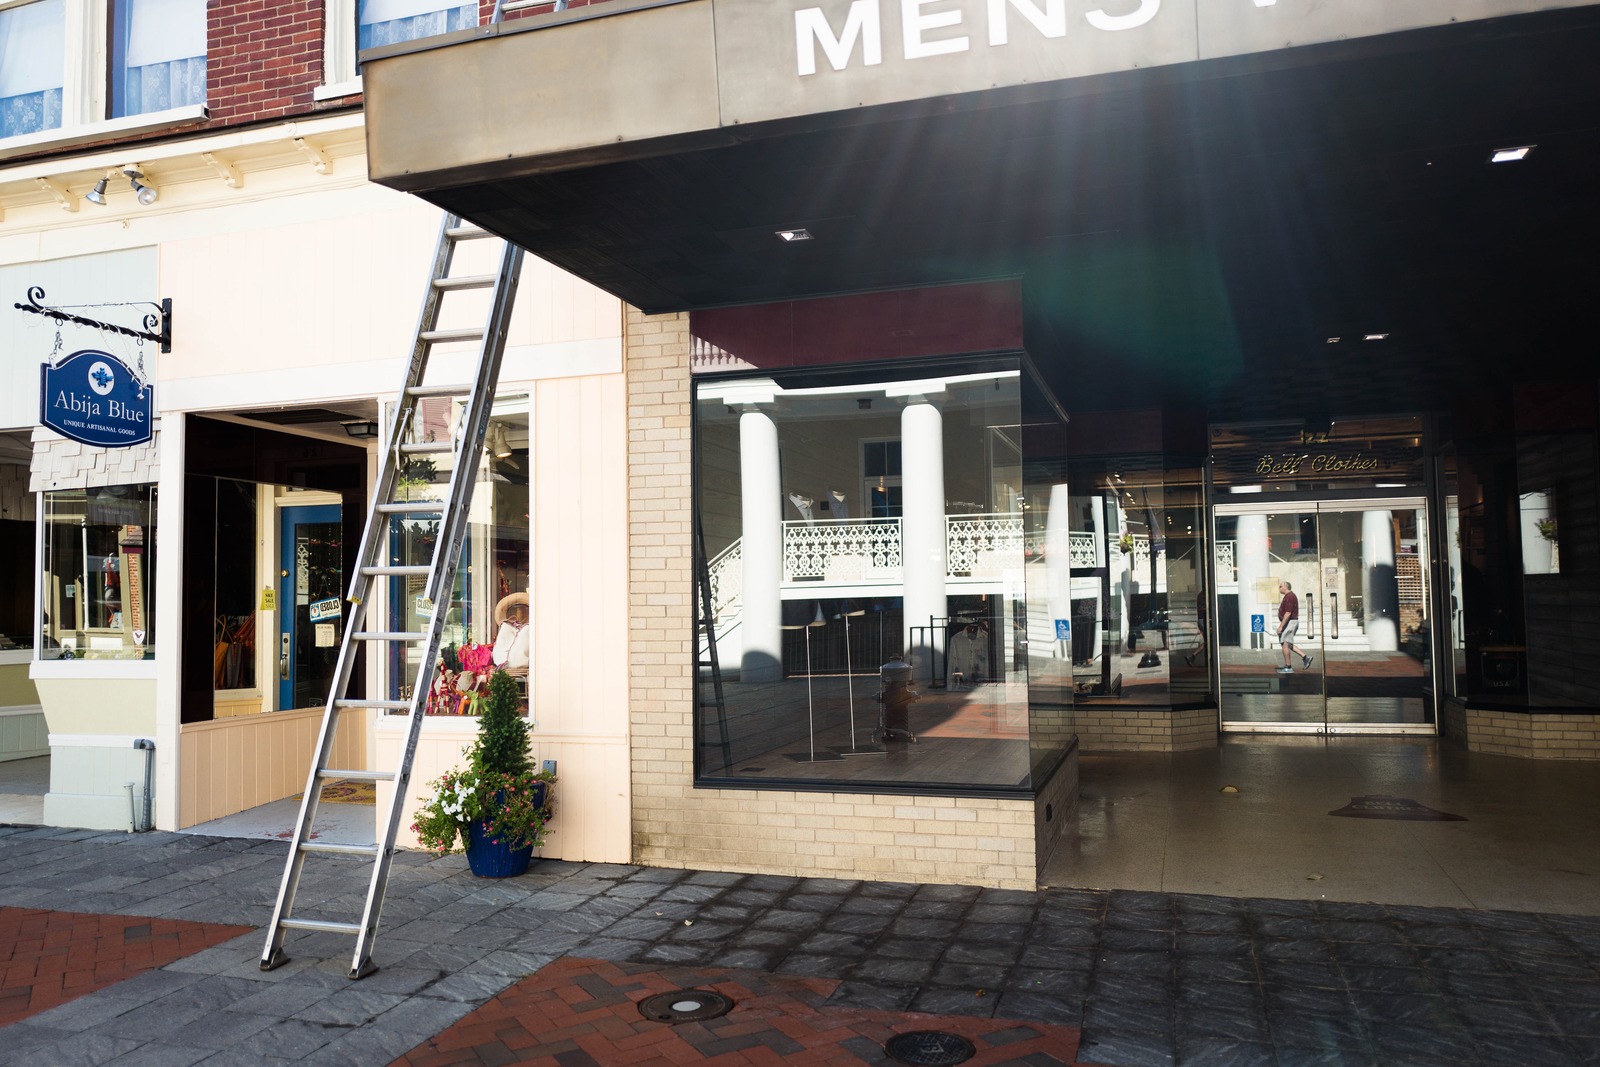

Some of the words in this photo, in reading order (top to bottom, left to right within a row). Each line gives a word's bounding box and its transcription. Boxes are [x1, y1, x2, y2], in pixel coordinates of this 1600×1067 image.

[54, 390, 100, 419] Abija
[108, 399, 144, 422] Blue
[63, 419, 86, 428] UNIQUE
[86, 423, 117, 433] ARTISANAL
[118, 428, 136, 436] GOODS
[1256, 455, 1305, 475] Bell
[1311, 453, 1378, 472] Clothes
[417, 598, 434, 611] CLOSE
